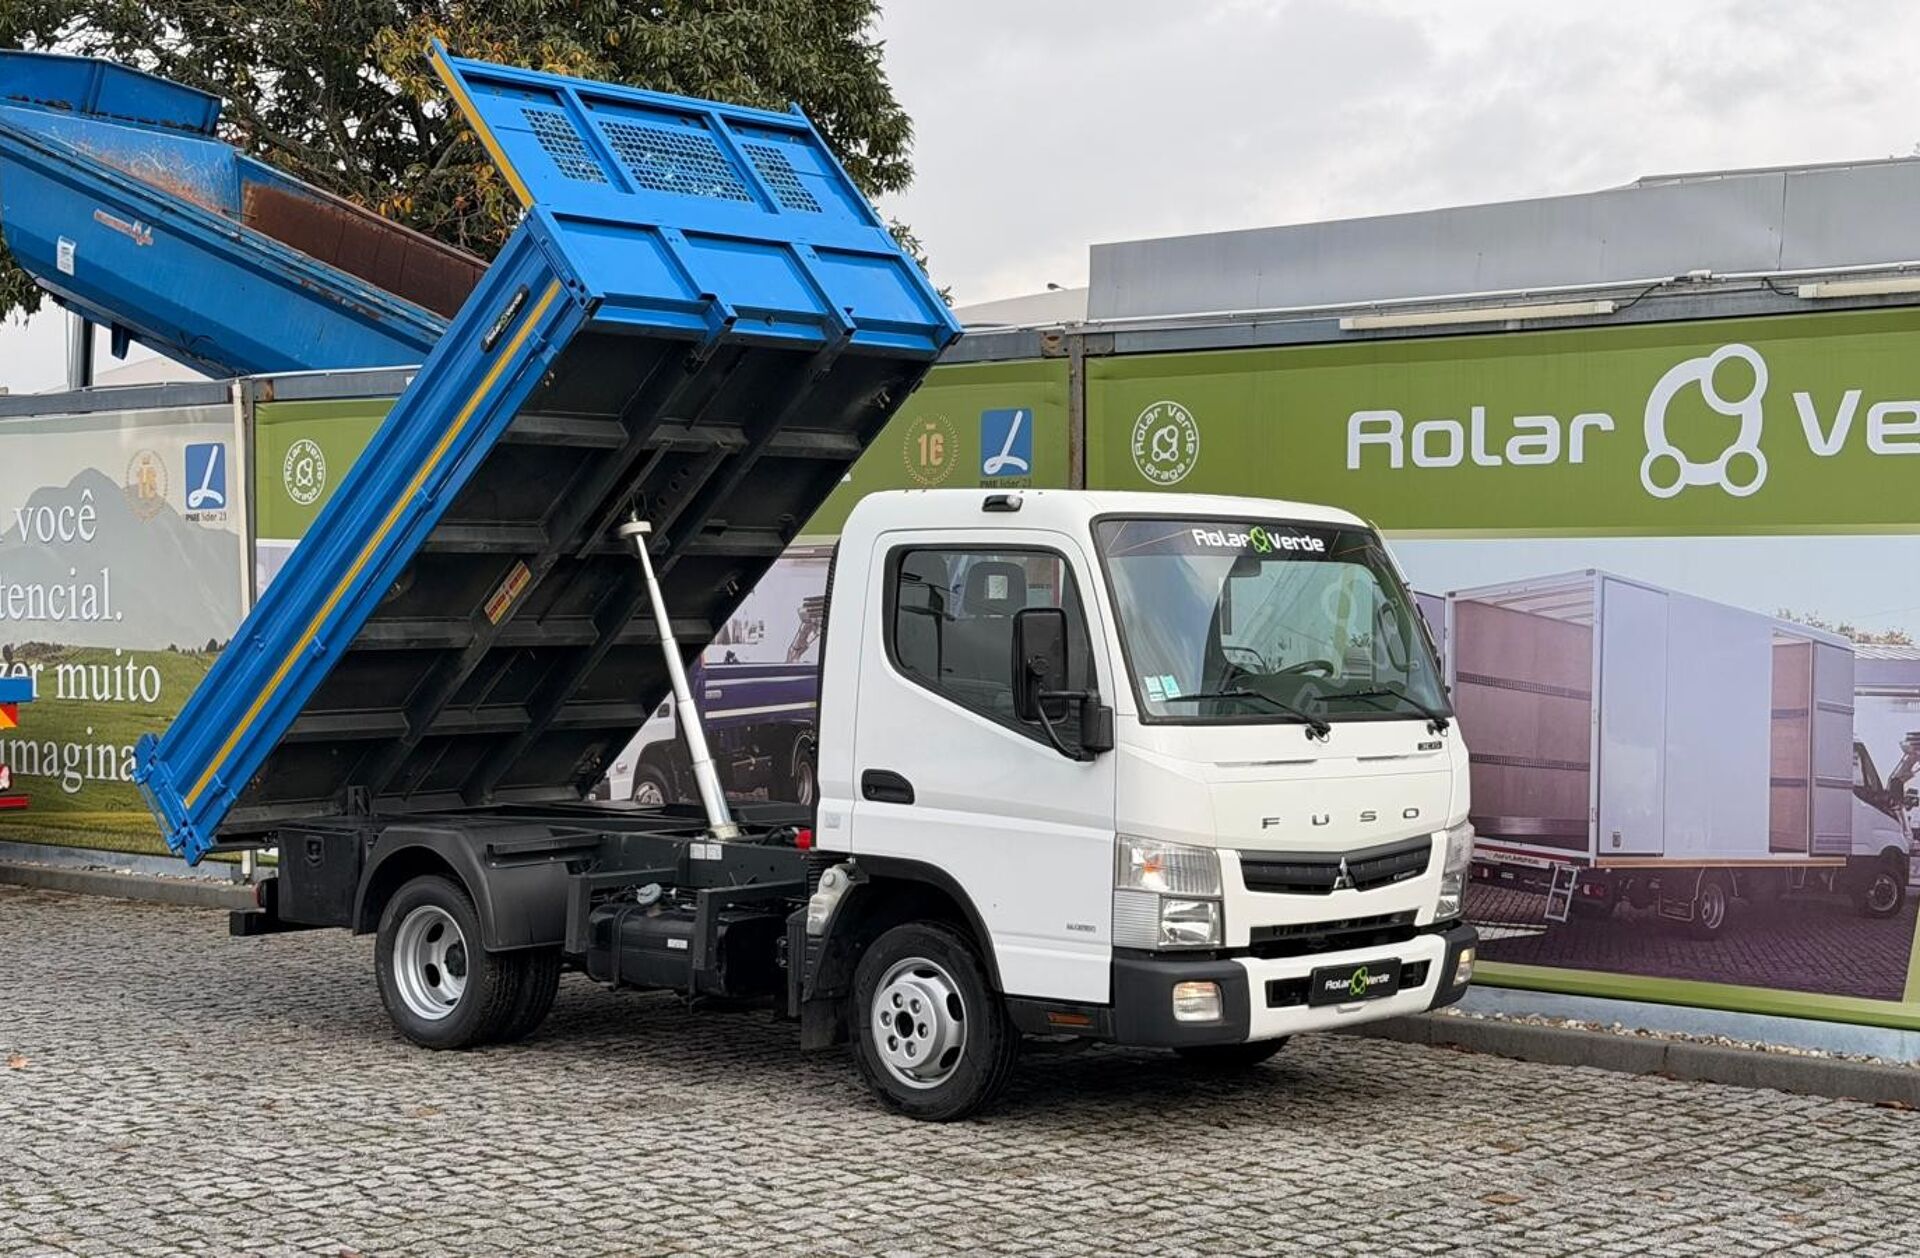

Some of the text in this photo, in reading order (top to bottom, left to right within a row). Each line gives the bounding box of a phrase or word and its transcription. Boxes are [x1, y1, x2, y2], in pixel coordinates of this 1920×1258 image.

[1167, 404, 1196, 455] Verde
[1346, 405, 1616, 470] Rolar
[14, 488, 97, 543] você
[1191, 528, 1326, 553] Rolar Verde
[55, 647, 161, 703] muito
[1261, 807, 1420, 830] FUSO
